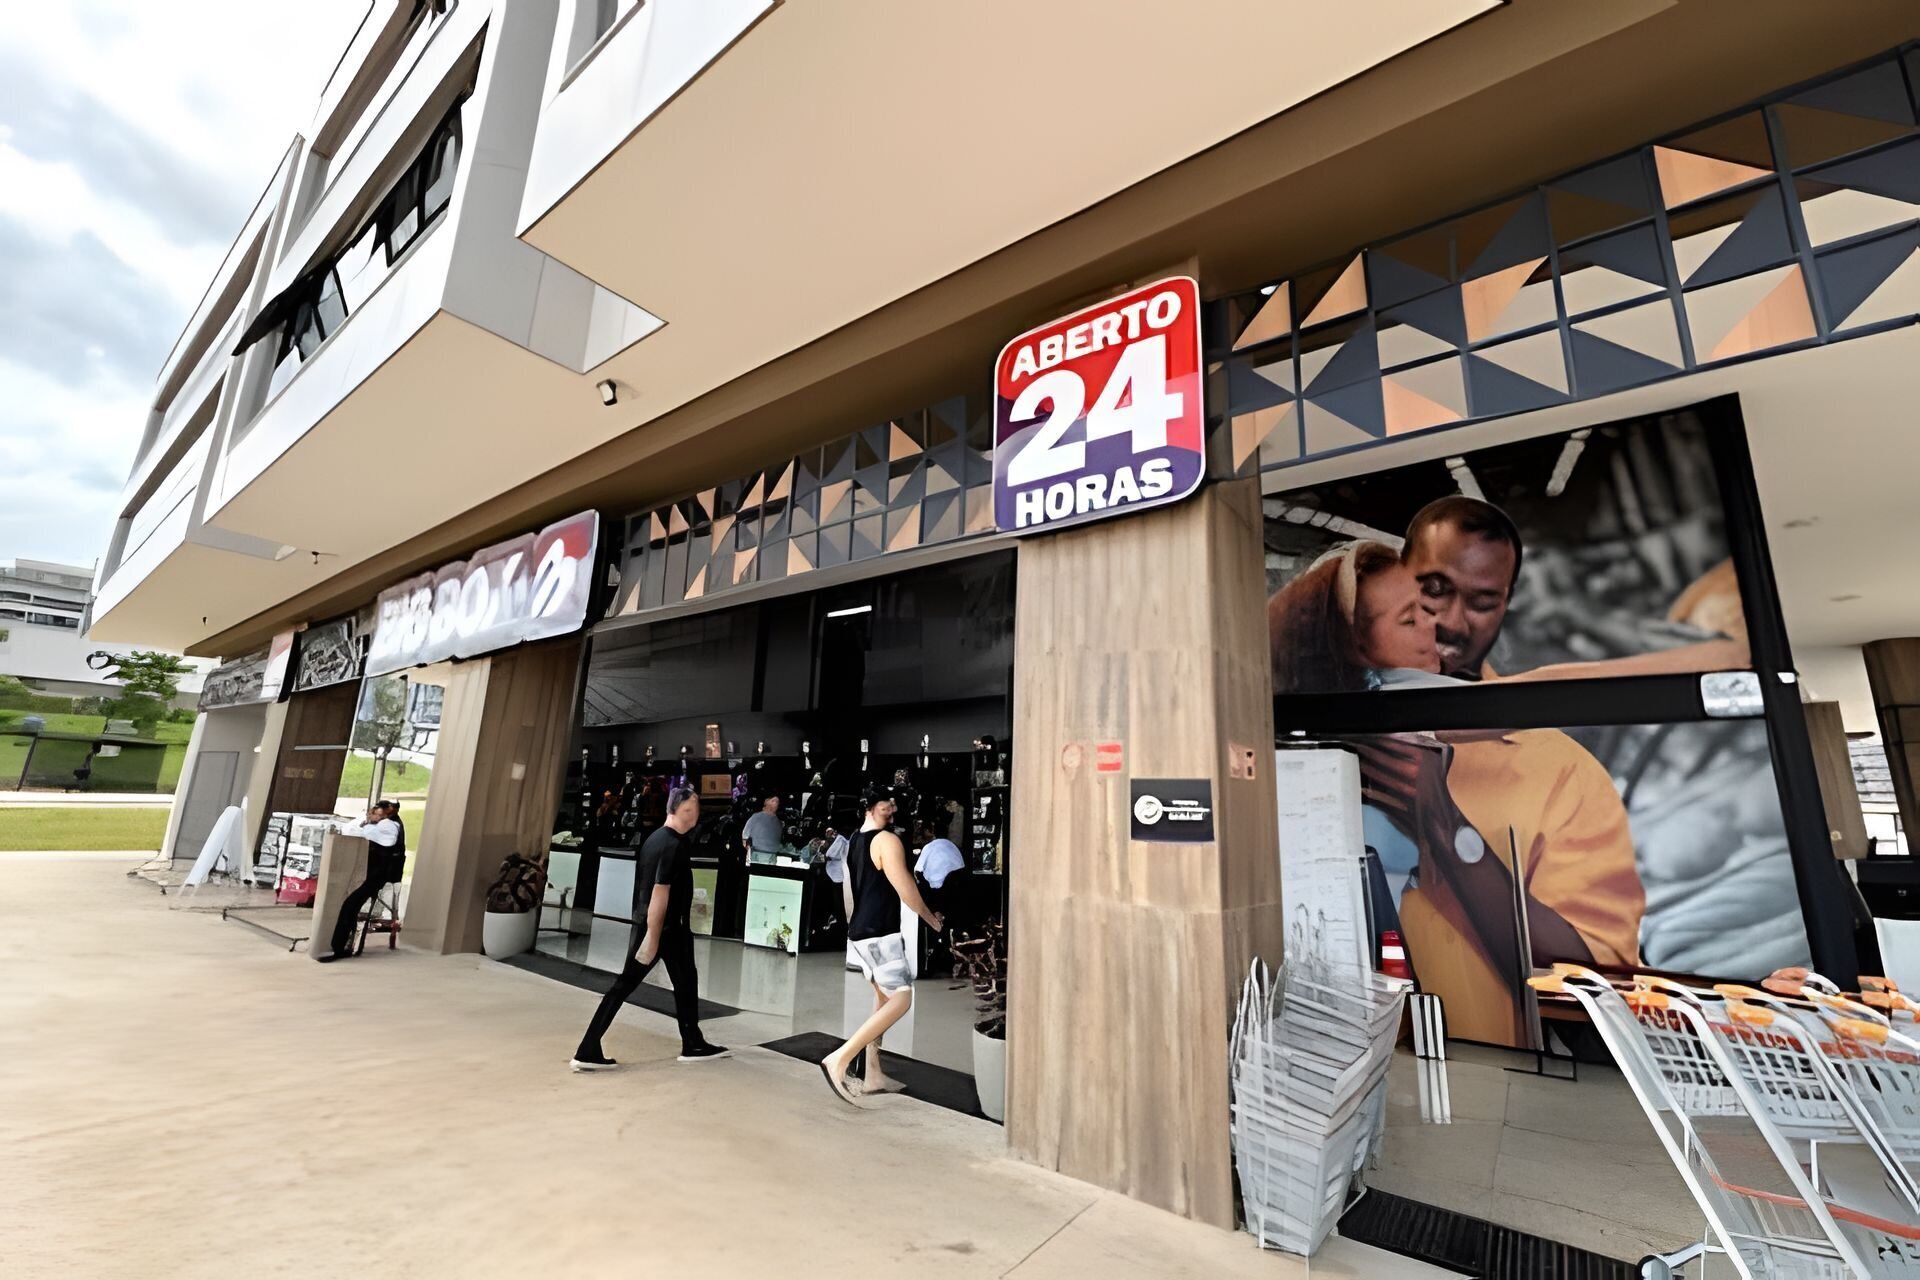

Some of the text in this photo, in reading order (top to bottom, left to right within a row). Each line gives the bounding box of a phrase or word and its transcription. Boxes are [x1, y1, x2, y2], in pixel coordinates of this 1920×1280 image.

[1010, 290, 1182, 382] ABERTO
[1007, 333, 1184, 487] 24
[1015, 457, 1173, 528] HORAS
